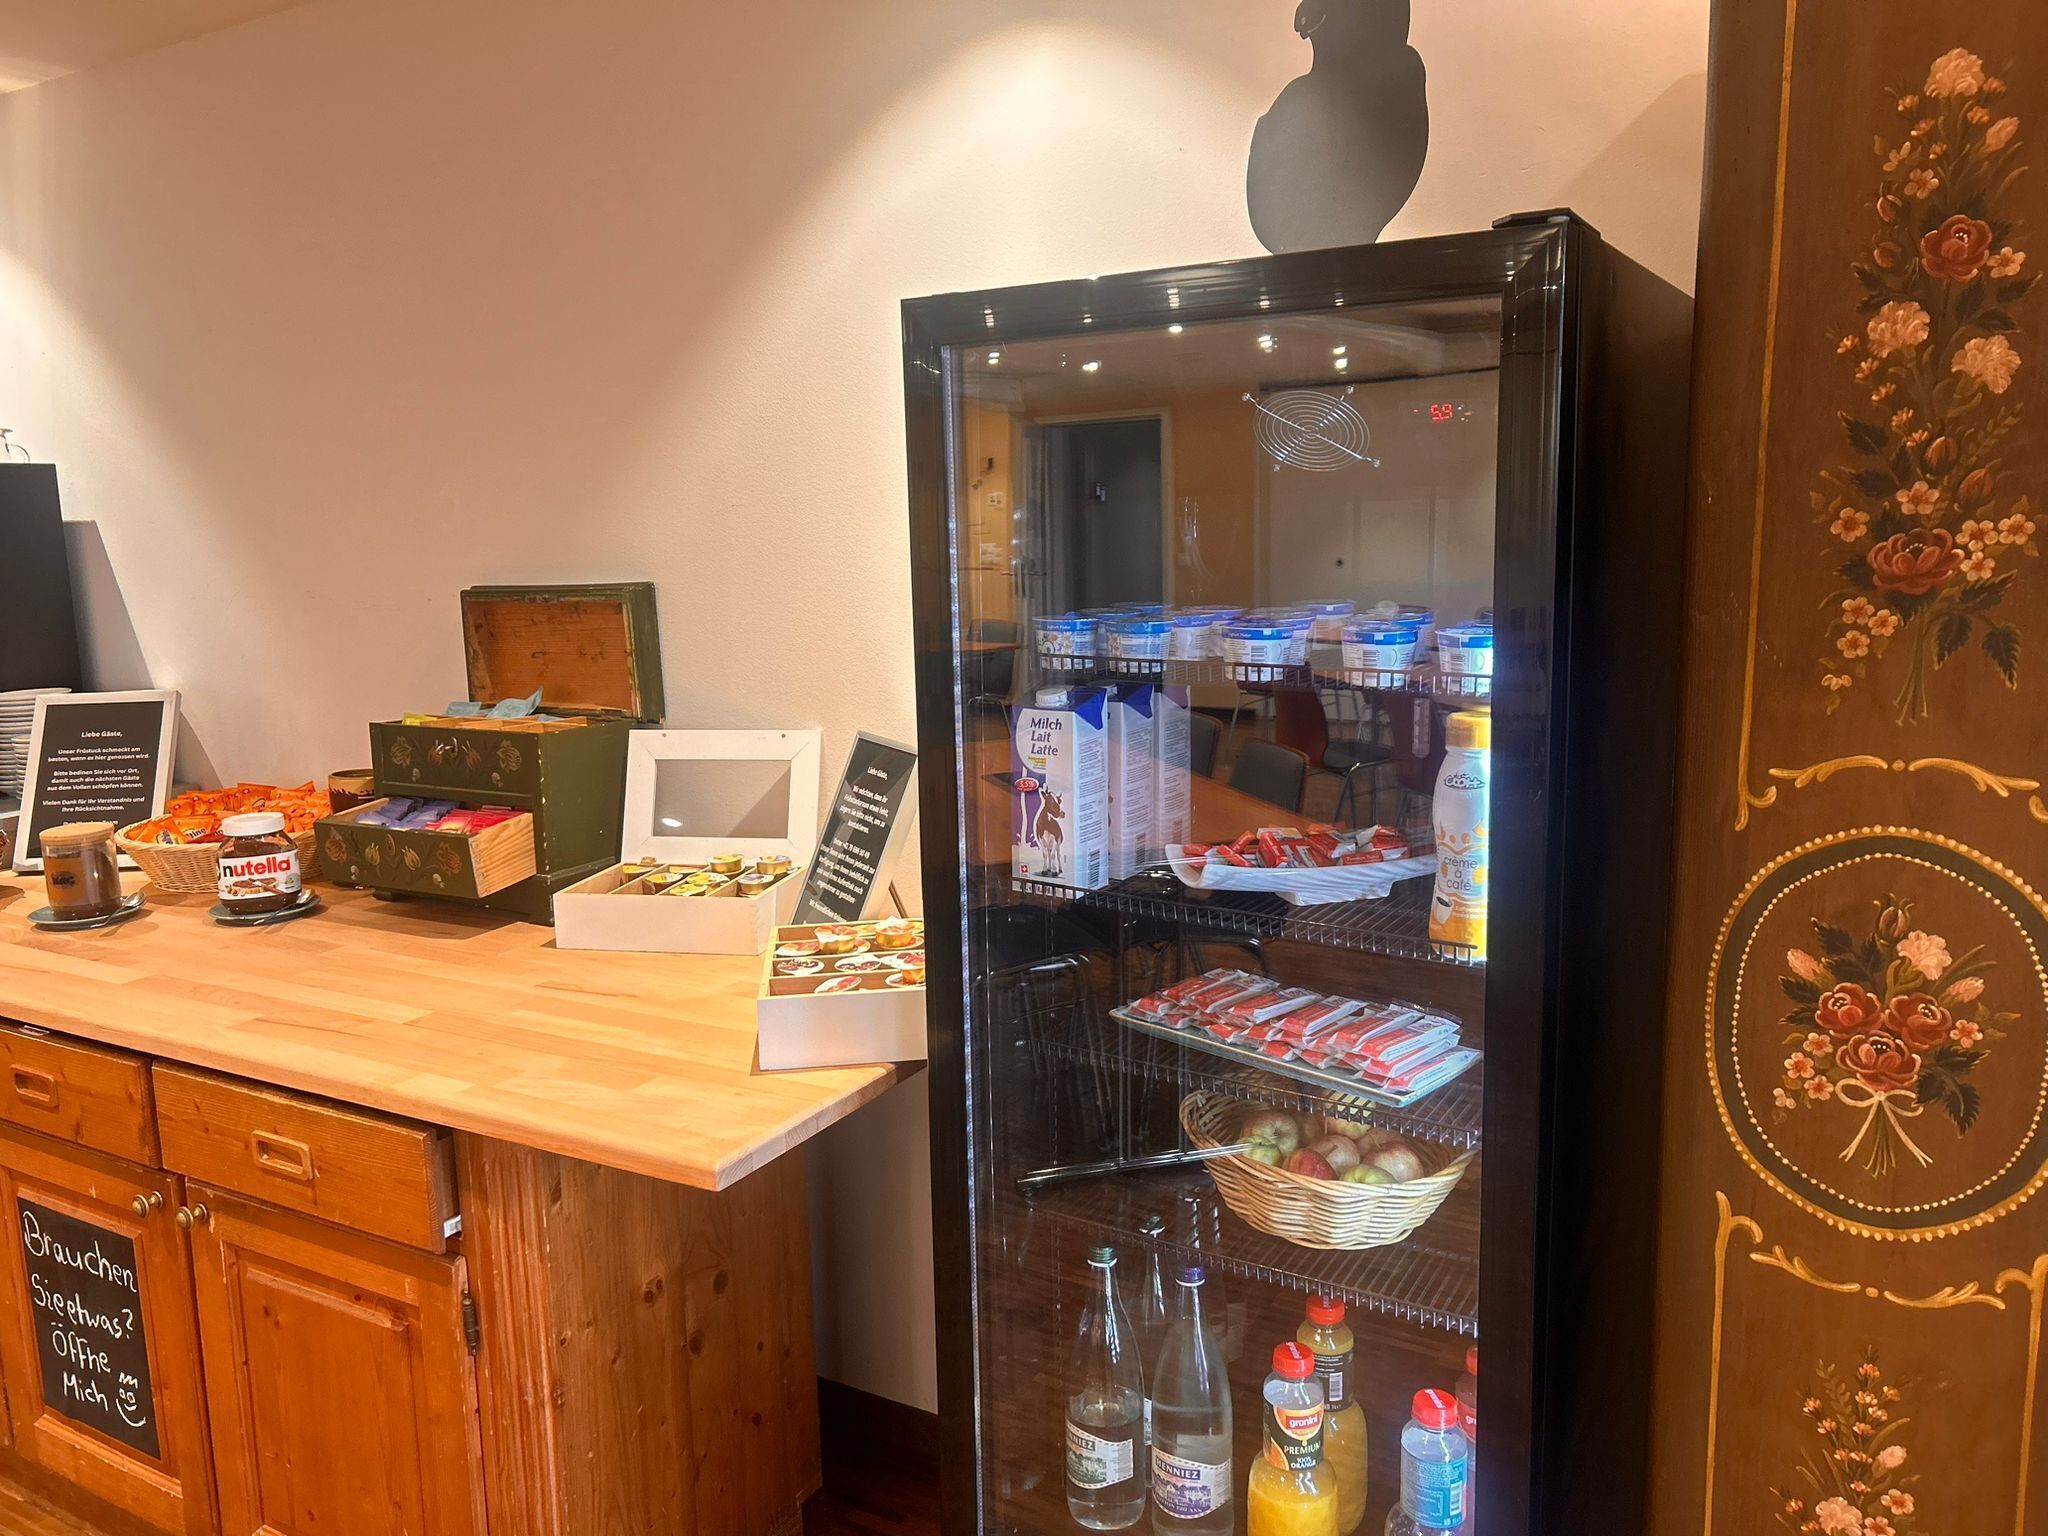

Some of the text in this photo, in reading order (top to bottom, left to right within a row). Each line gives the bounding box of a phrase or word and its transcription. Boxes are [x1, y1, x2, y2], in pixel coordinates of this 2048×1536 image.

[1030, 717, 1062, 730] Milch
[1030, 730, 1051, 742] Lait
[1030, 743, 1058, 756] Latte
[222, 856, 291, 878] nutella
[1444, 856, 1477, 868] crème
[1447, 880, 1472, 890] café
[23, 1210, 137, 1292] Brauchen
[51, 1322, 110, 1373] Öffne
[63, 1371, 109, 1411] Mich
[1289, 1413, 1319, 1429] granini
[1284, 1441, 1321, 1455] PREMIUM
[1157, 1455, 1199, 1479] HENNIEZ
